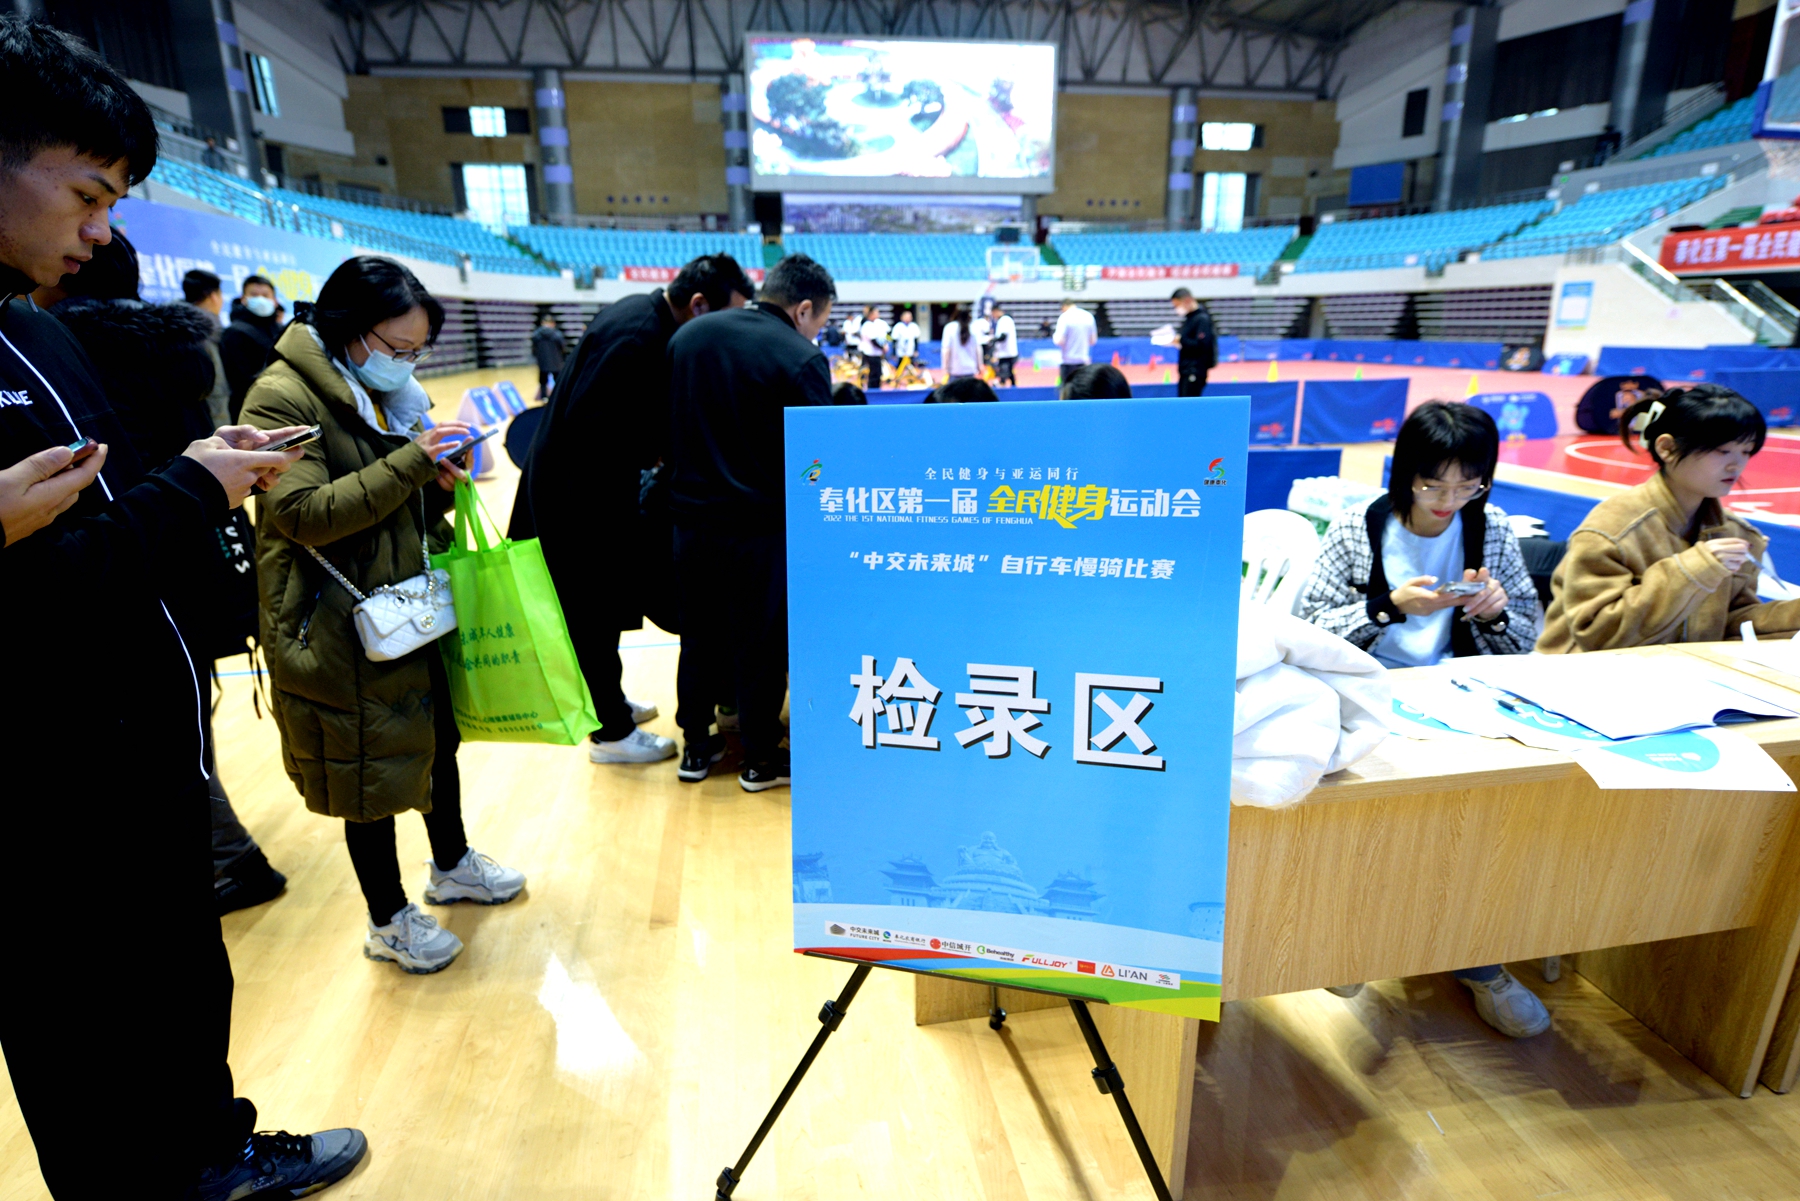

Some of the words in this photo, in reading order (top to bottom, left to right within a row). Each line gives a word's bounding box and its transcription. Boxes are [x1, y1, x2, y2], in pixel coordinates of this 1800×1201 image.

[925, 467, 1079, 481] 全民健身与亚运同行
[823, 514, 842, 523] 2022
[845, 514, 859, 523] THE
[861, 514, 874, 523] 1ST
[876, 515, 914, 523] NATIONAL
[916, 515, 949, 524] FITNESS
[951, 516, 980, 525] GAMES
[982, 517, 993, 525] OF
[995, 517, 1034, 526] FENGHUA
[848, 654, 1167, 772] 检录区
[850, 926, 880, 936] 中交未来城
[850, 932, 868, 940] FUTURE
[941, 940, 972, 952] 中信城开
[986, 948, 1015, 958] Behealthy
[1118, 968, 1148, 981] LI'AN
